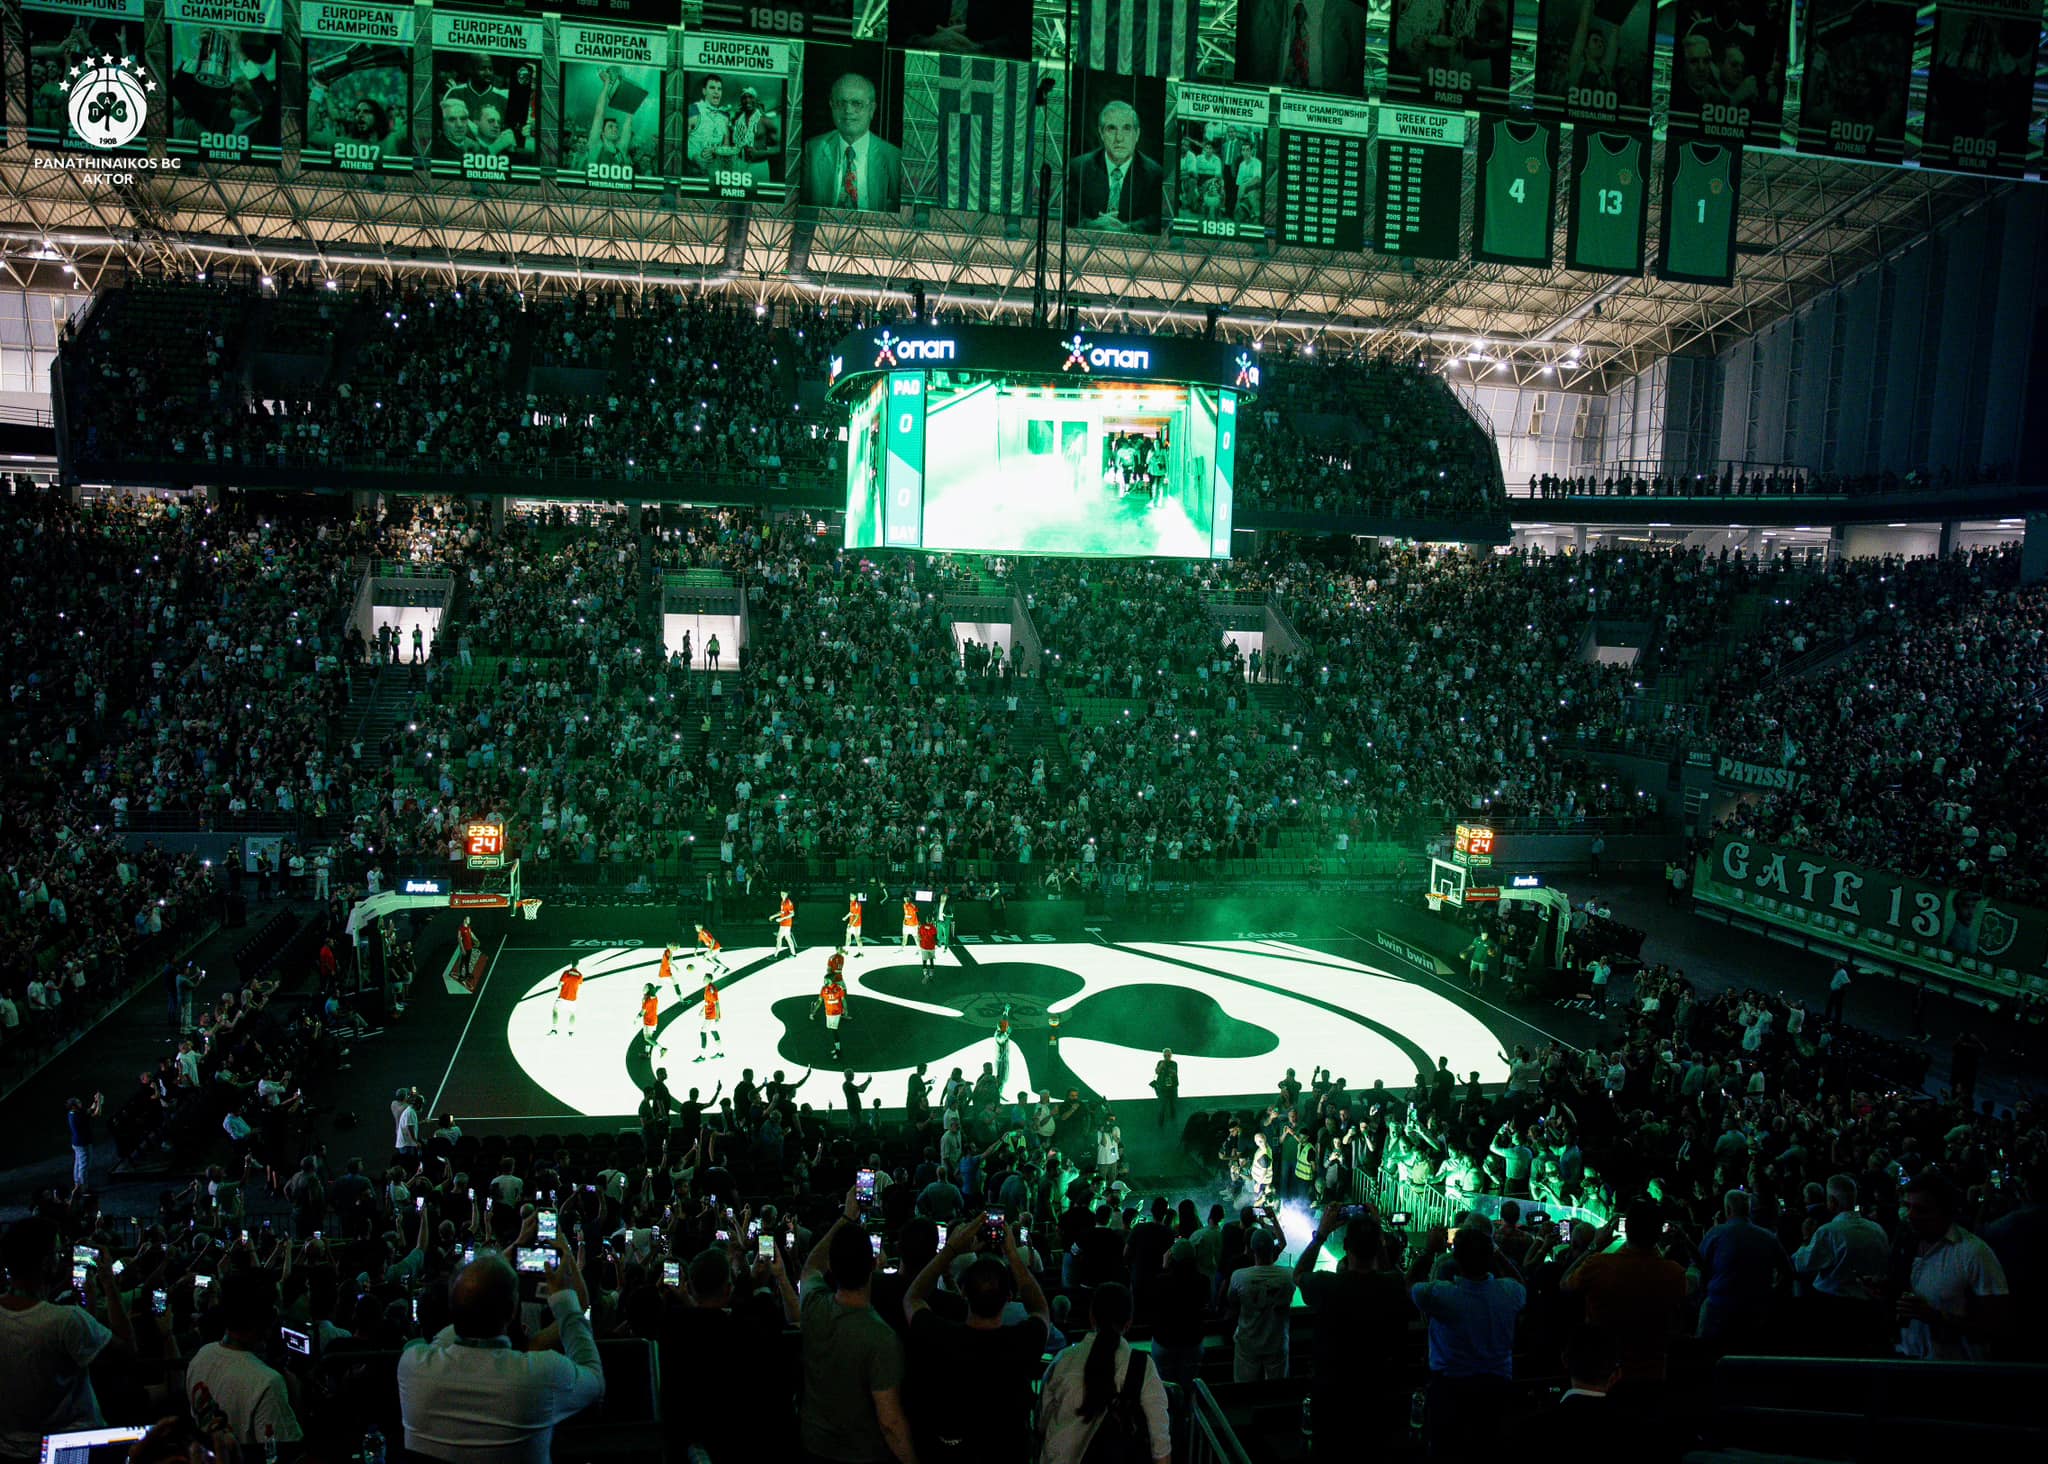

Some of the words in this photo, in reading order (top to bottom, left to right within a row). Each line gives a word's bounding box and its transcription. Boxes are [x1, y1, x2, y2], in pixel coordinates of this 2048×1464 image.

[182, 5, 266, 24] CHAMPIONS
[322, 6, 394, 24] EUROPEAN
[749, 7, 804, 33] 1996
[317, 19, 399, 37] CHAMPIONS
[453, 19, 523, 37] EUROPEAN
[447, 31, 528, 50] CHAMPIONS
[579, 31, 648, 48] EUROPEAN
[574, 43, 652, 62] CHAMPIONS
[703, 41, 770, 57] EUROPEAN
[699, 53, 774, 70] CHAMPIONS
[1427, 67, 1472, 91] 1996
[1181, 90, 1265, 110] INTERCONTINENTAL
[1434, 90, 1463, 105] PARIS
[1568, 86, 1617, 111] 2000
[1192, 102, 1210, 113] CUP
[1212, 104, 1254, 118] WINNERS
[1282, 102, 1307, 113] GREEK
[1308, 104, 1368, 120] CHAMPIONSHIP
[1701, 102, 1751, 126] 2002
[1306, 114, 1344, 125] WINNERS
[1396, 112, 1426, 126] GREEK
[1429, 115, 1448, 128] CUP
[1399, 124, 1445, 138] WINNERS
[1703, 123, 1746, 139] BOLOGNA
[1829, 119, 1876, 143] 2007
[200, 132, 249, 152] 2009
[1951, 135, 1998, 158] 2009
[209, 150, 241, 161] BERLIN
[334, 143, 381, 161] 2007
[340, 160, 374, 171] ATHENS
[462, 153, 510, 171] 2002
[466, 170, 506, 182] BOLOGNA
[587, 163, 633, 181] 2000
[714, 170, 753, 187] 1996
[721, 187, 746, 198] PARIS
[1508, 178, 1526, 204] 4
[1598, 188, 1623, 215] 13
[1696, 199, 1705, 224] 1
[1202, 219, 1236, 237] 1996
[894, 379, 921, 396] PAO
[899, 413, 913, 433] 0
[898, 488, 911, 507] 0
[471, 837, 496, 852] 24
[1471, 839, 1490, 852] 24
[1723, 841, 1865, 917] GATE
[1886, 886, 1942, 938] 13
[851, 933, 1057, 944] ATENS
[1377, 932, 1403, 955] bwin
[1406, 946, 1435, 972] bwin
